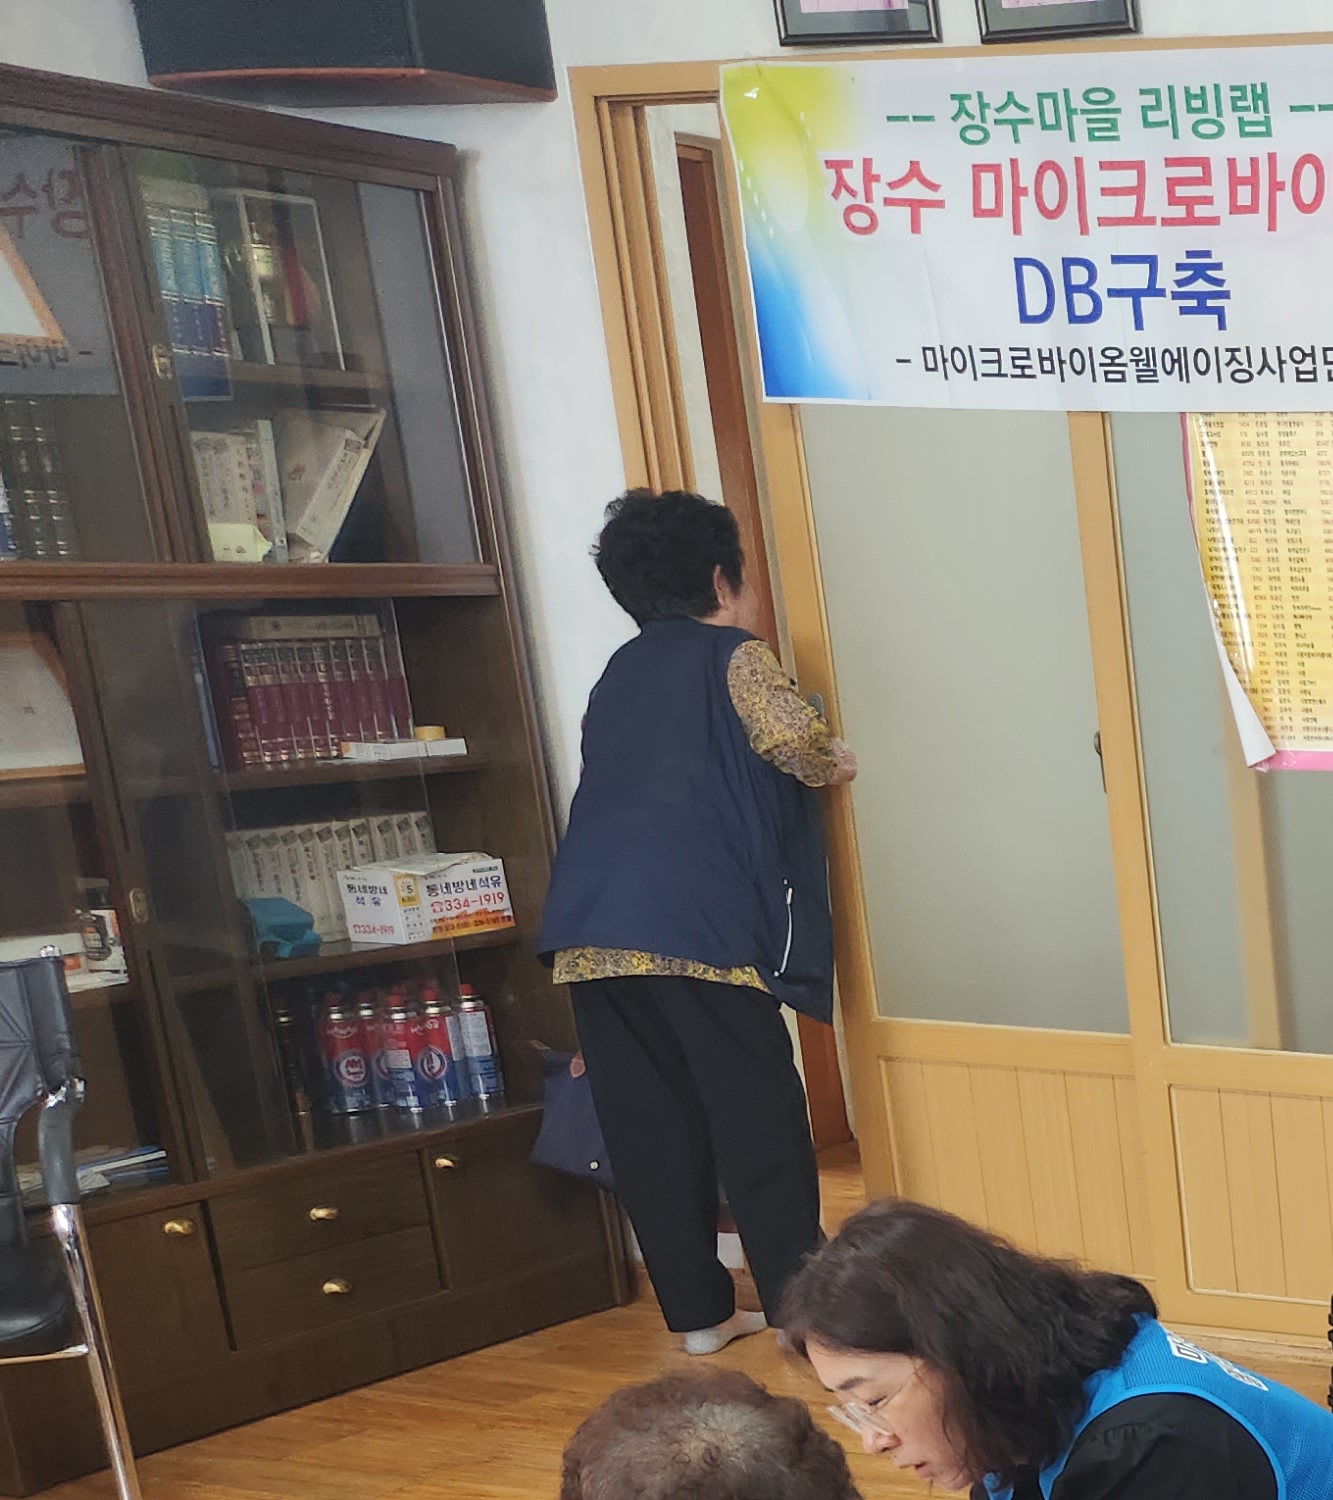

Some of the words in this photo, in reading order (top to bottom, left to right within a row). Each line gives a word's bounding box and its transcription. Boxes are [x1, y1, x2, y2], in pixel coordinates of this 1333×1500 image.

[950, 88, 1122, 148] 장수마을
[1140, 79, 1273, 139] 리빙랩
[824, 156, 948, 236] 장수
[1014, 250, 1232, 331] DB구축
